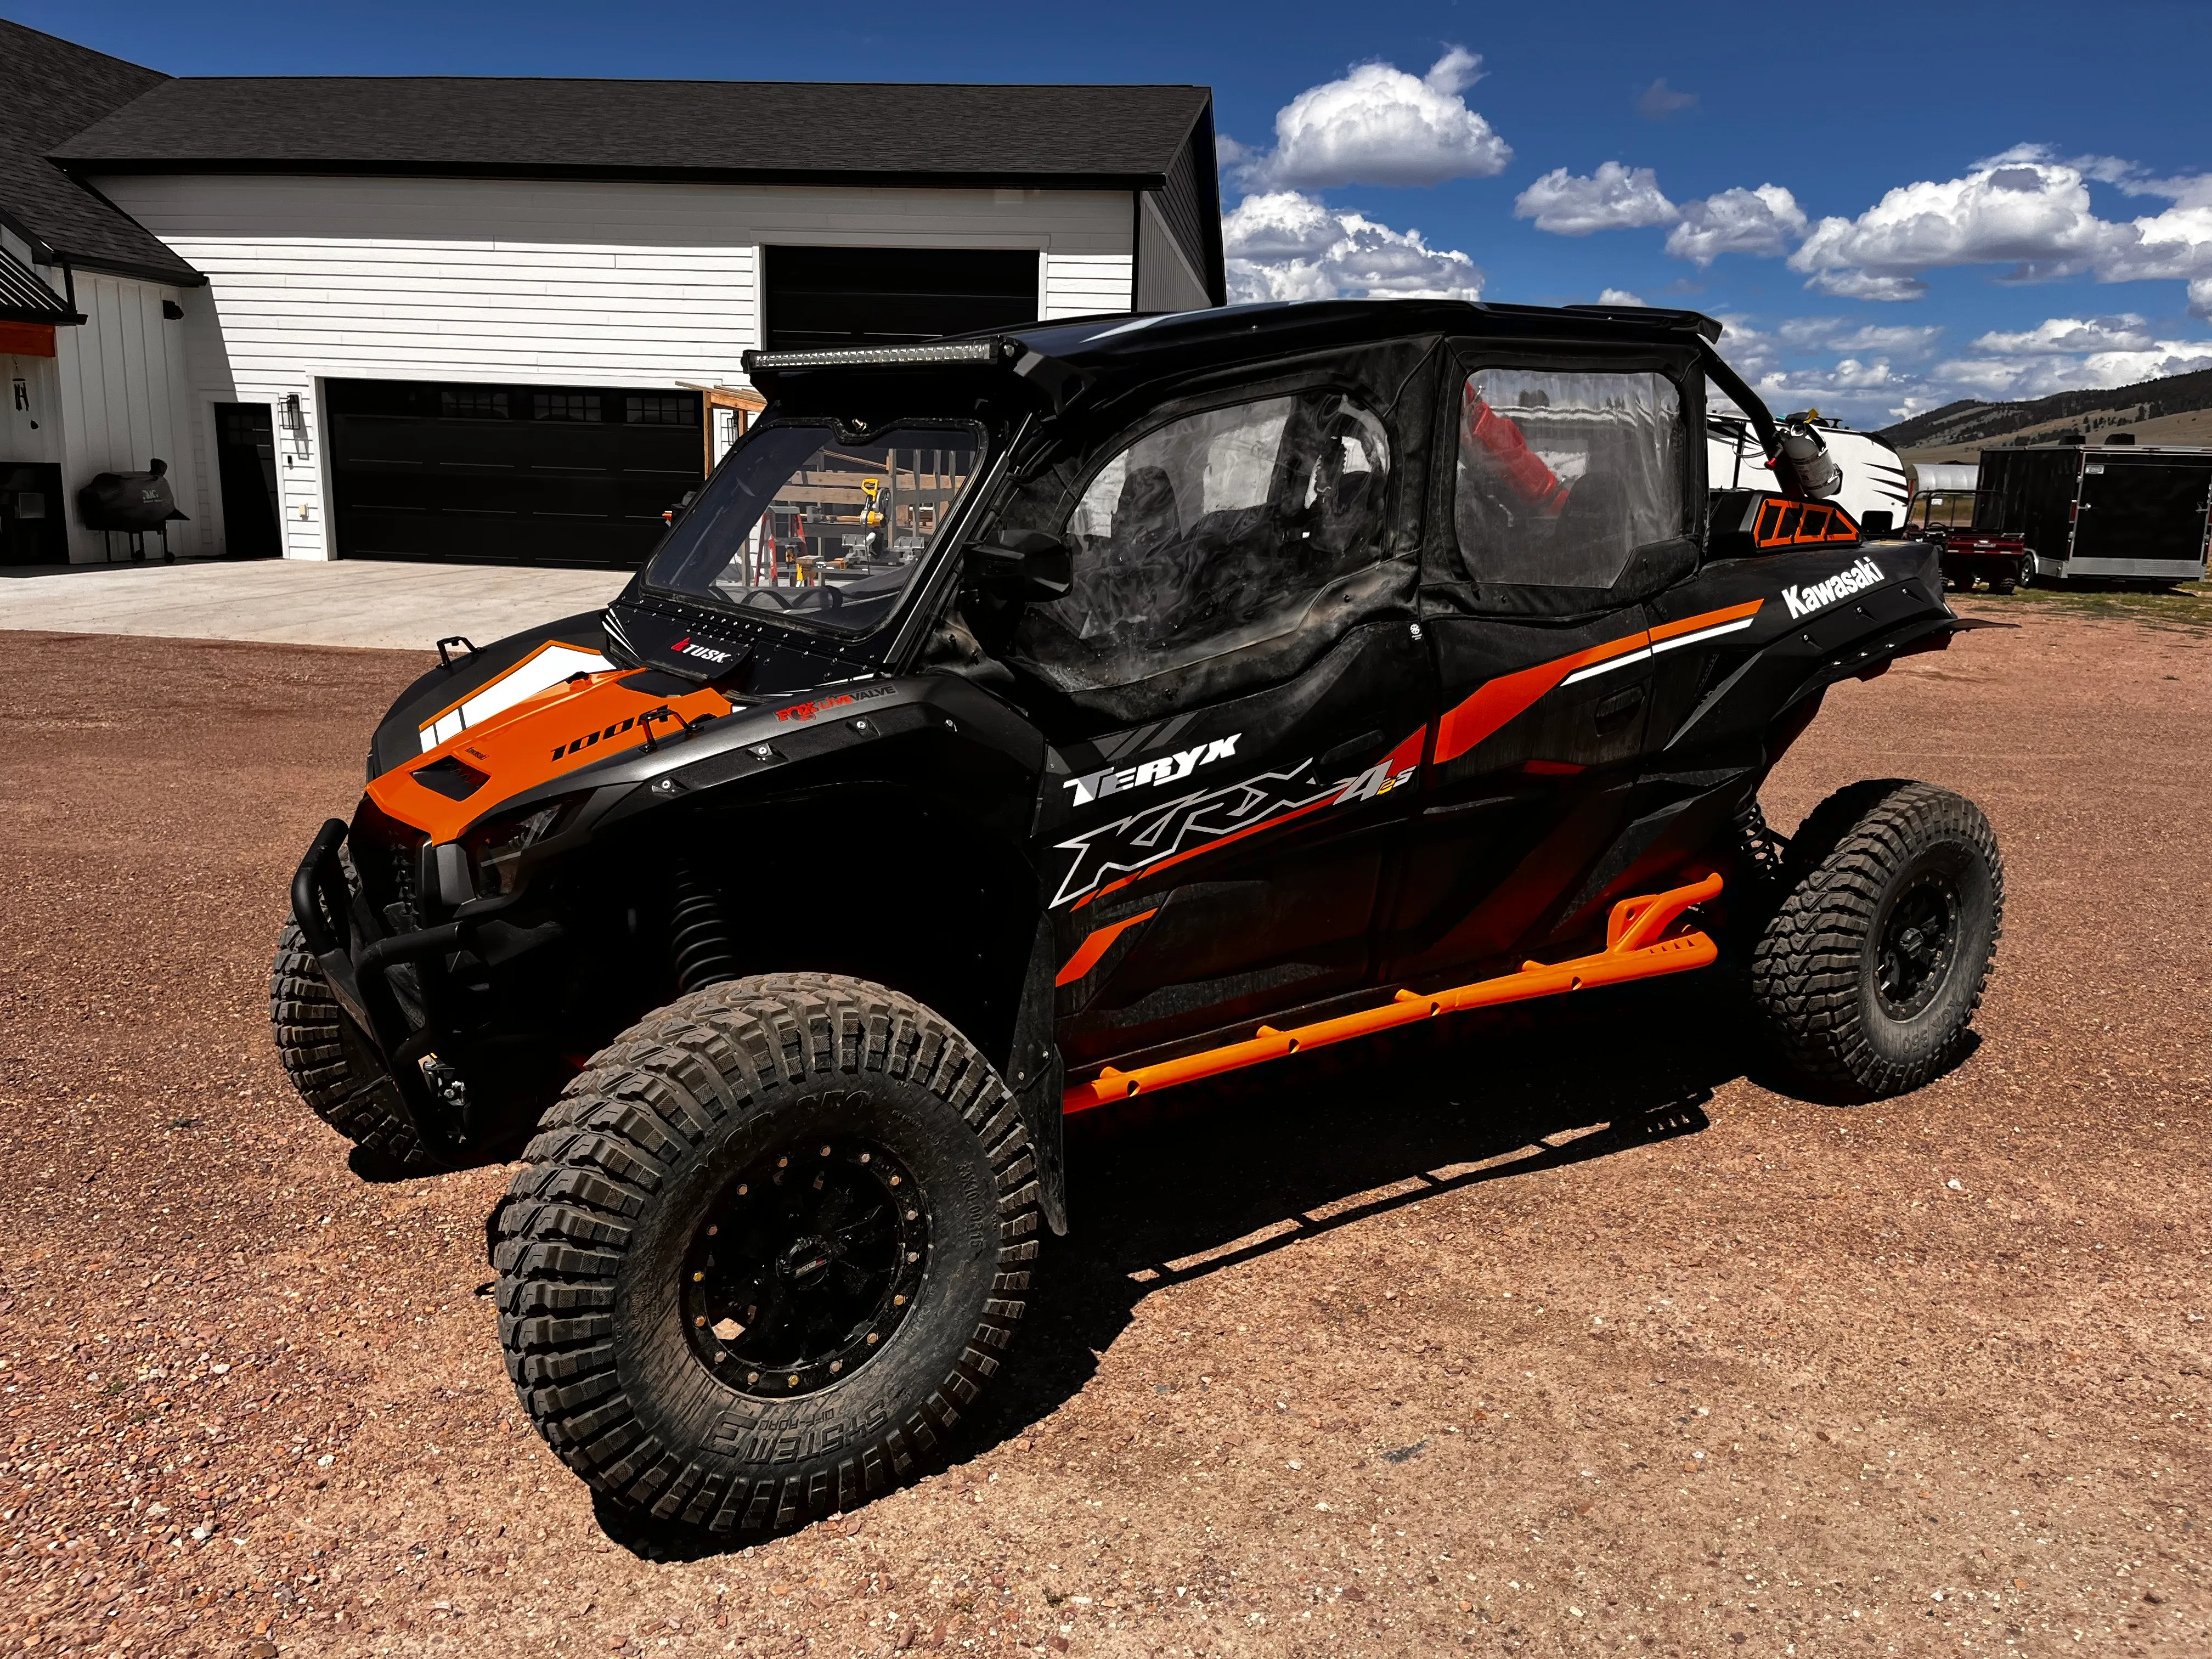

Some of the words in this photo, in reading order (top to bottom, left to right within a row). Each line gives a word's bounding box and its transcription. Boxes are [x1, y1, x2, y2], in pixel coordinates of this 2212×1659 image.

[1781, 556, 1884, 619] Kawasaki
[682, 644, 731, 663] TUSK
[776, 701, 819, 722] FOX
[1063, 733, 1242, 807] TERYX
[698, 1410, 758, 1458] 3
[743, 1399, 889, 1465] SYSTEM
[757, 1407, 834, 1431] OFF-ROAD
